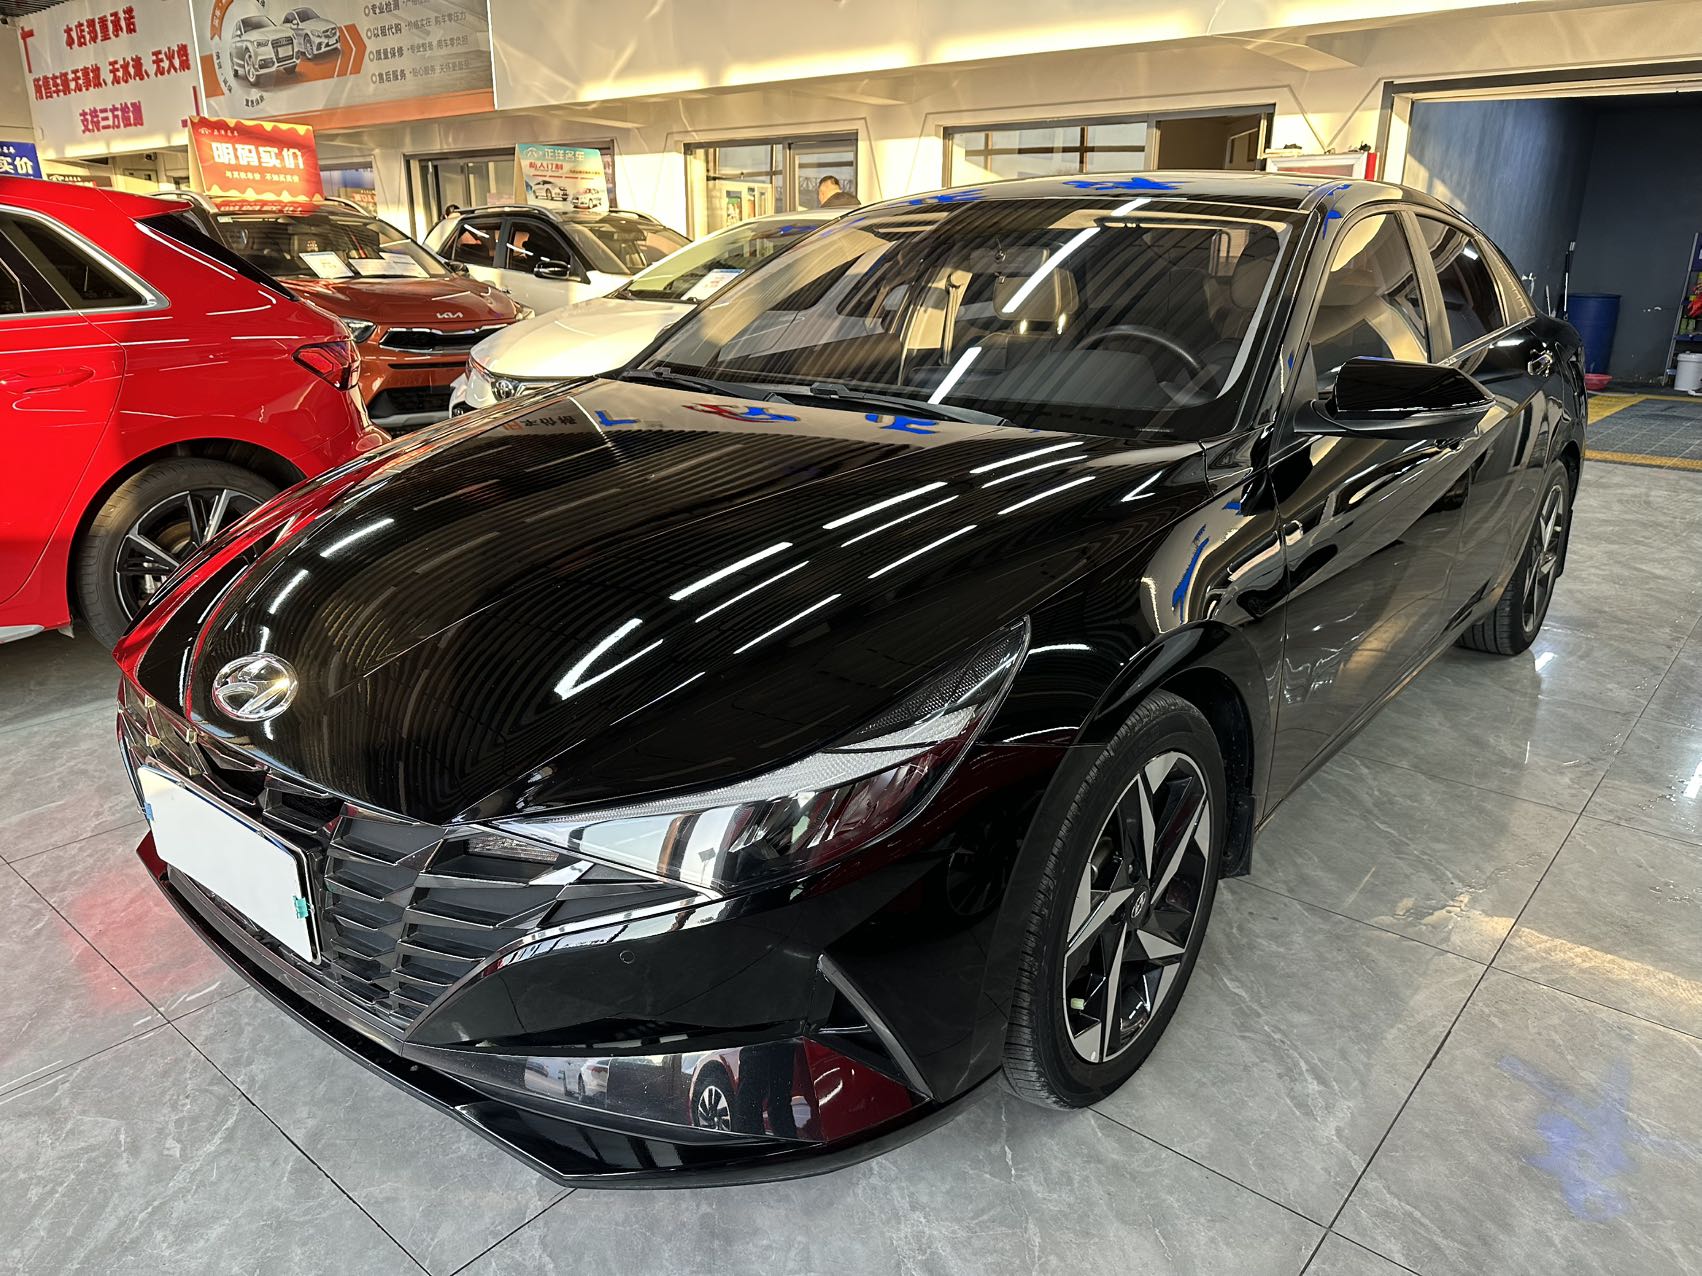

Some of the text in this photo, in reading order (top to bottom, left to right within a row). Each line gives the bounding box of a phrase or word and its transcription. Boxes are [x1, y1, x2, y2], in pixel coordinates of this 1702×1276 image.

[371, 0, 399, 15] 专业检测
[64, 6, 137, 49] 本店郑重承诺
[373, 23, 402, 38] 以租代购
[375, 46, 404, 60] 质量保修
[378, 69, 407, 83] 售后服务
[79, 100, 144, 134] 支持三方检测
[211, 142, 304, 169] 明码实价
